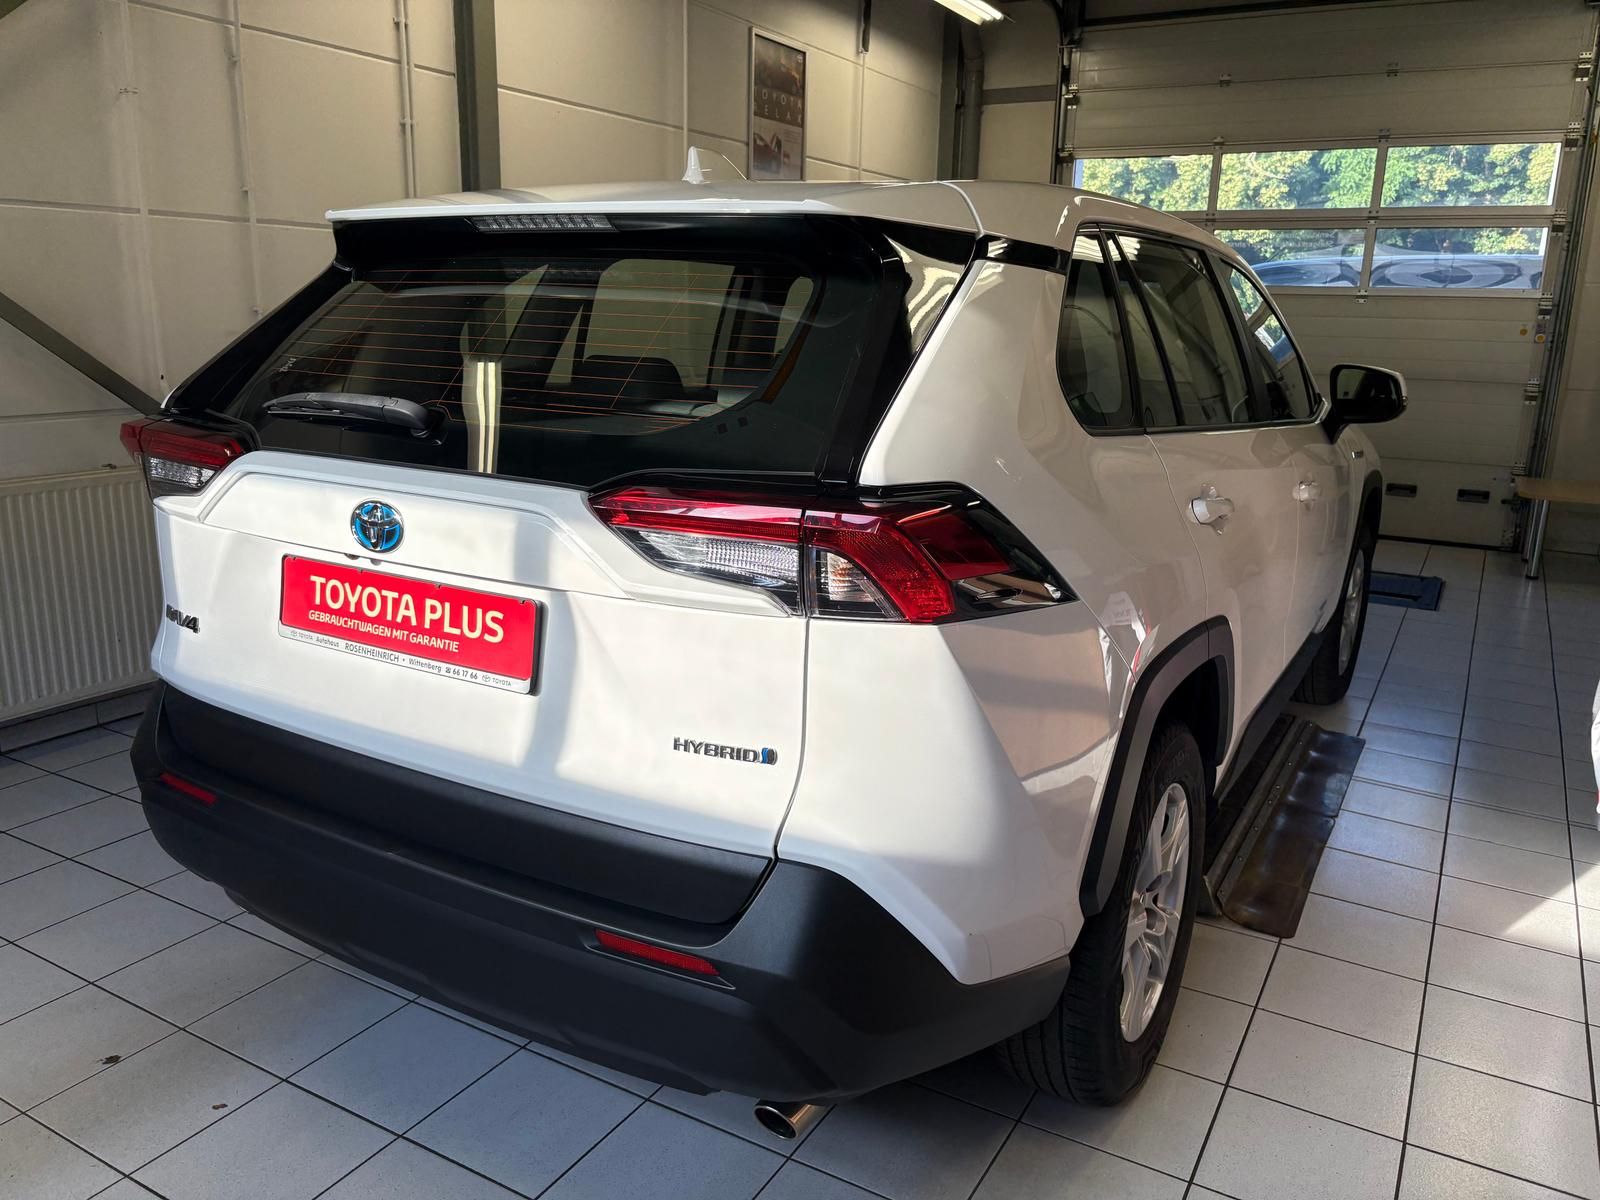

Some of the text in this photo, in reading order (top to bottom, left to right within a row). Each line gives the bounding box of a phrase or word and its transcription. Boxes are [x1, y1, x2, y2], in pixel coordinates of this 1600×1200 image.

[166, 603, 200, 634] RAV4
[310, 575, 504, 643] TOYOTA PLUS
[308, 610, 459, 652] GEBRAUCHTWAGEN MIT GARANTIE
[316, 636, 339, 648] Autohaus
[345, 642, 399, 663] ROSENHEINRICH
[409, 657, 441, 673] Wittenberg
[452, 667, 460, 676] 66
[462, 669, 468, 678] 17
[470, 671, 478, 680] 66
[492, 677, 511, 686] TOYOTA
[673, 737, 760, 763] HYBRID
